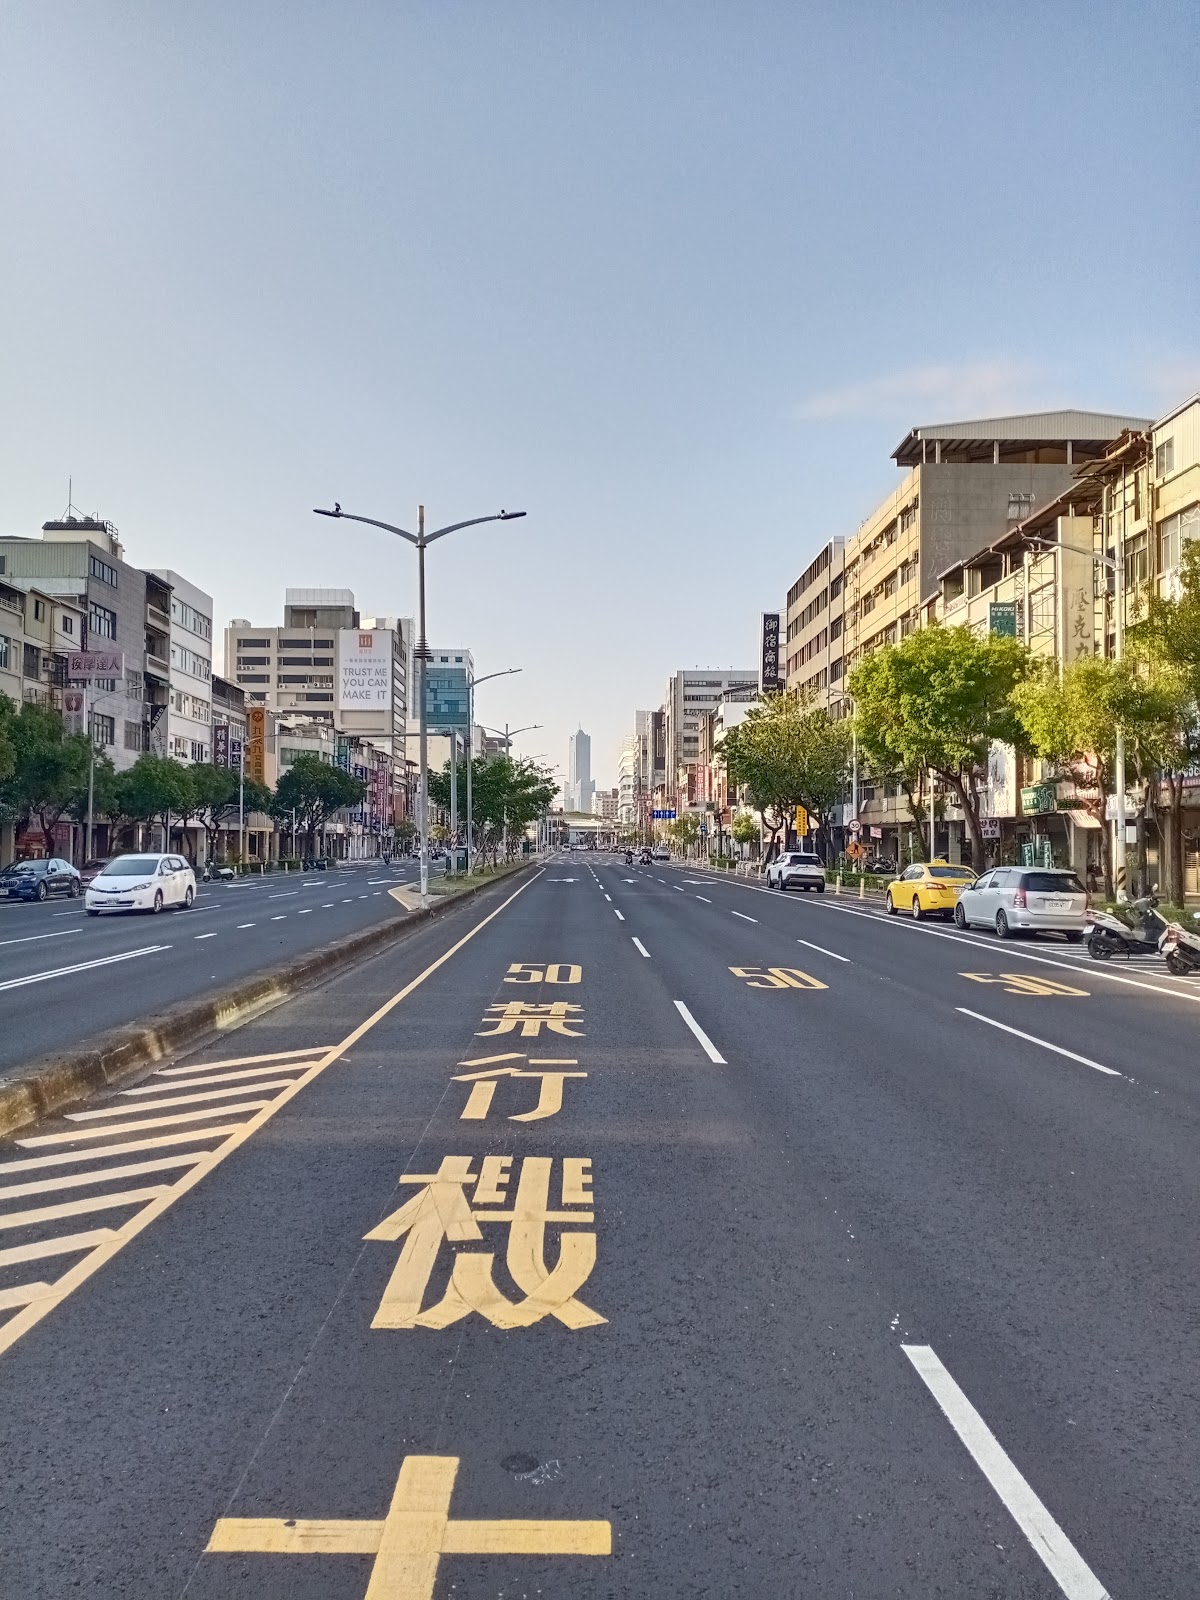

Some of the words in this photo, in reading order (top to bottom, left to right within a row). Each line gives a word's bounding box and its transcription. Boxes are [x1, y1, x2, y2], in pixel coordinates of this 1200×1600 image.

[764, 618, 778, 678] 御宿商旅
[71, 656, 120, 671] 按摩達人
[343, 667, 373, 676] TRUST
[374, 668, 387, 677] ME
[342, 678, 365, 689] YOU
[367, 678, 387, 687] CAN
[342, 690, 371, 700] MAKE
[377, 690, 387, 700] IT
[503, 963, 583, 984] 50
[727, 966, 830, 990] 50
[957, 971, 1091, 997] 50
